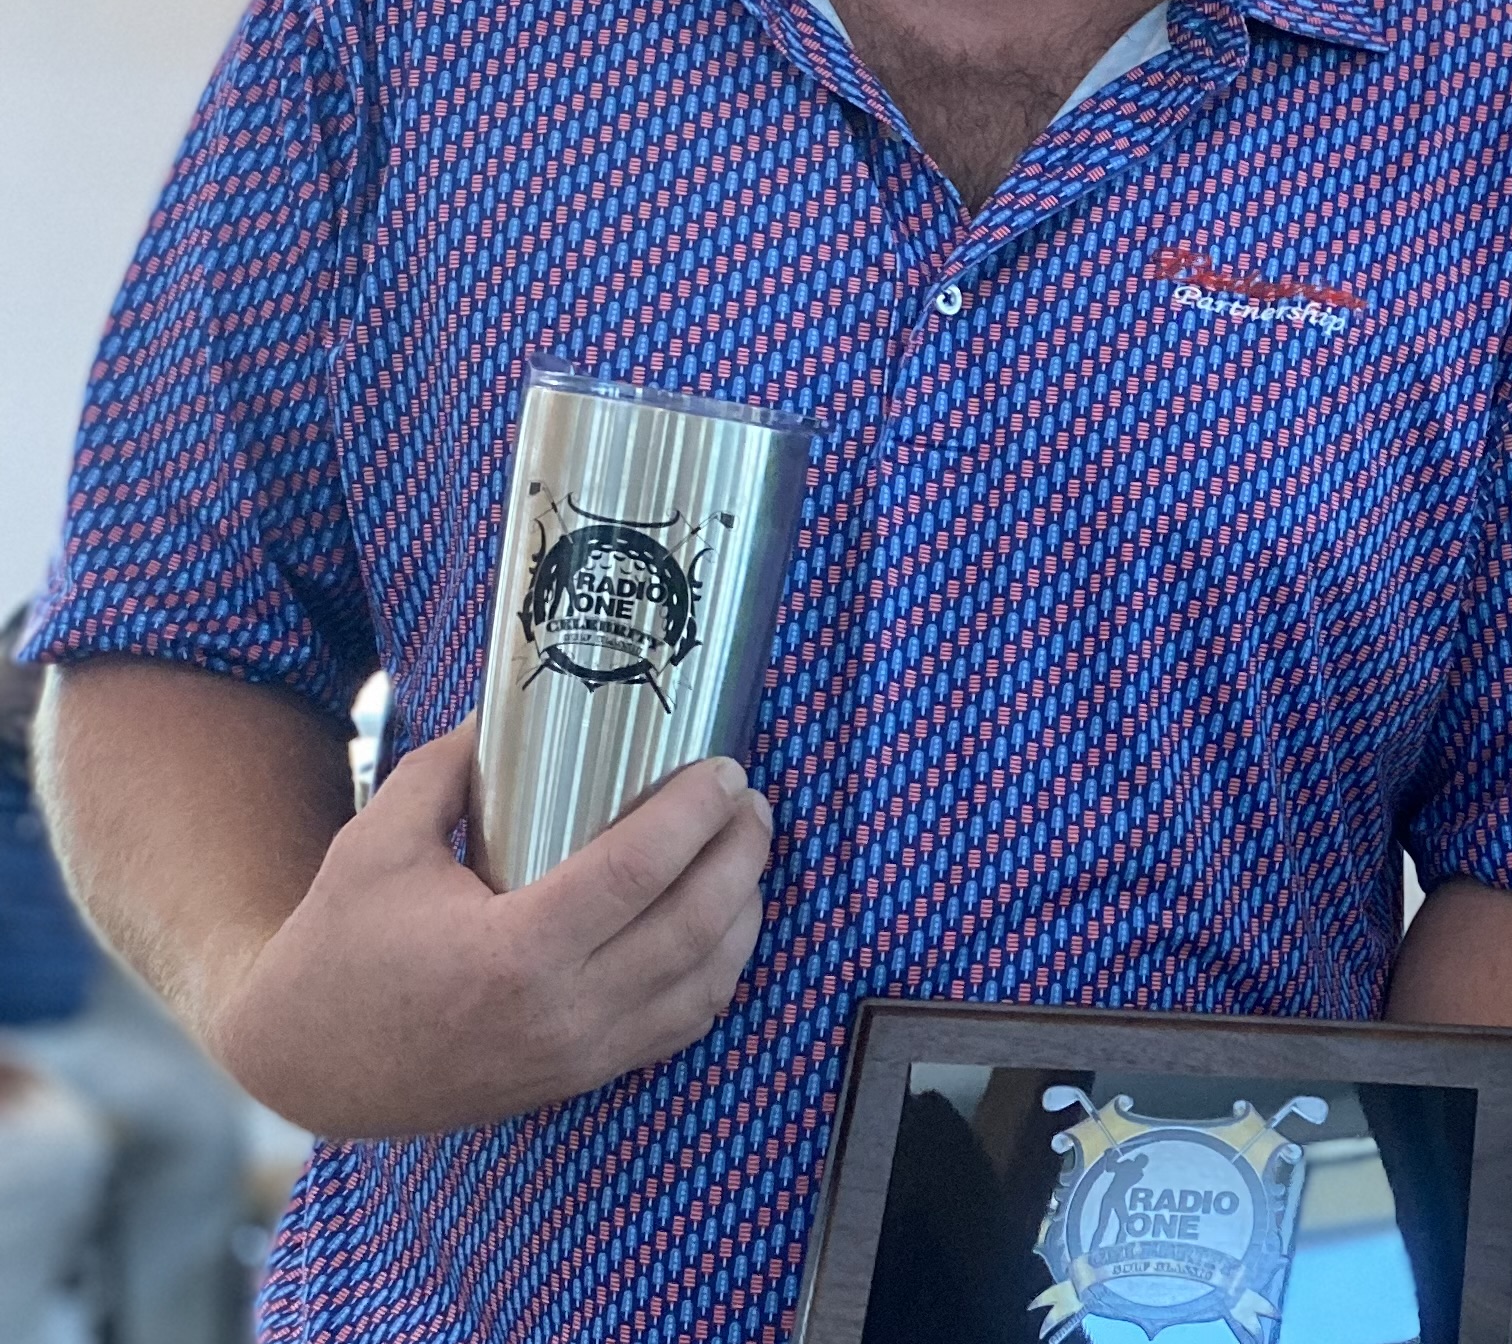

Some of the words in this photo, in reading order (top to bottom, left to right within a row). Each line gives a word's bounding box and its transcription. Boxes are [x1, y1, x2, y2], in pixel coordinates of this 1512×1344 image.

[1174, 286, 1345, 336] Partnership
[577, 571, 668, 604] RADIO
[574, 592, 634, 619] ONE
[1128, 1187, 1240, 1215] RADIO
[1126, 1212, 1200, 1240] ONE
